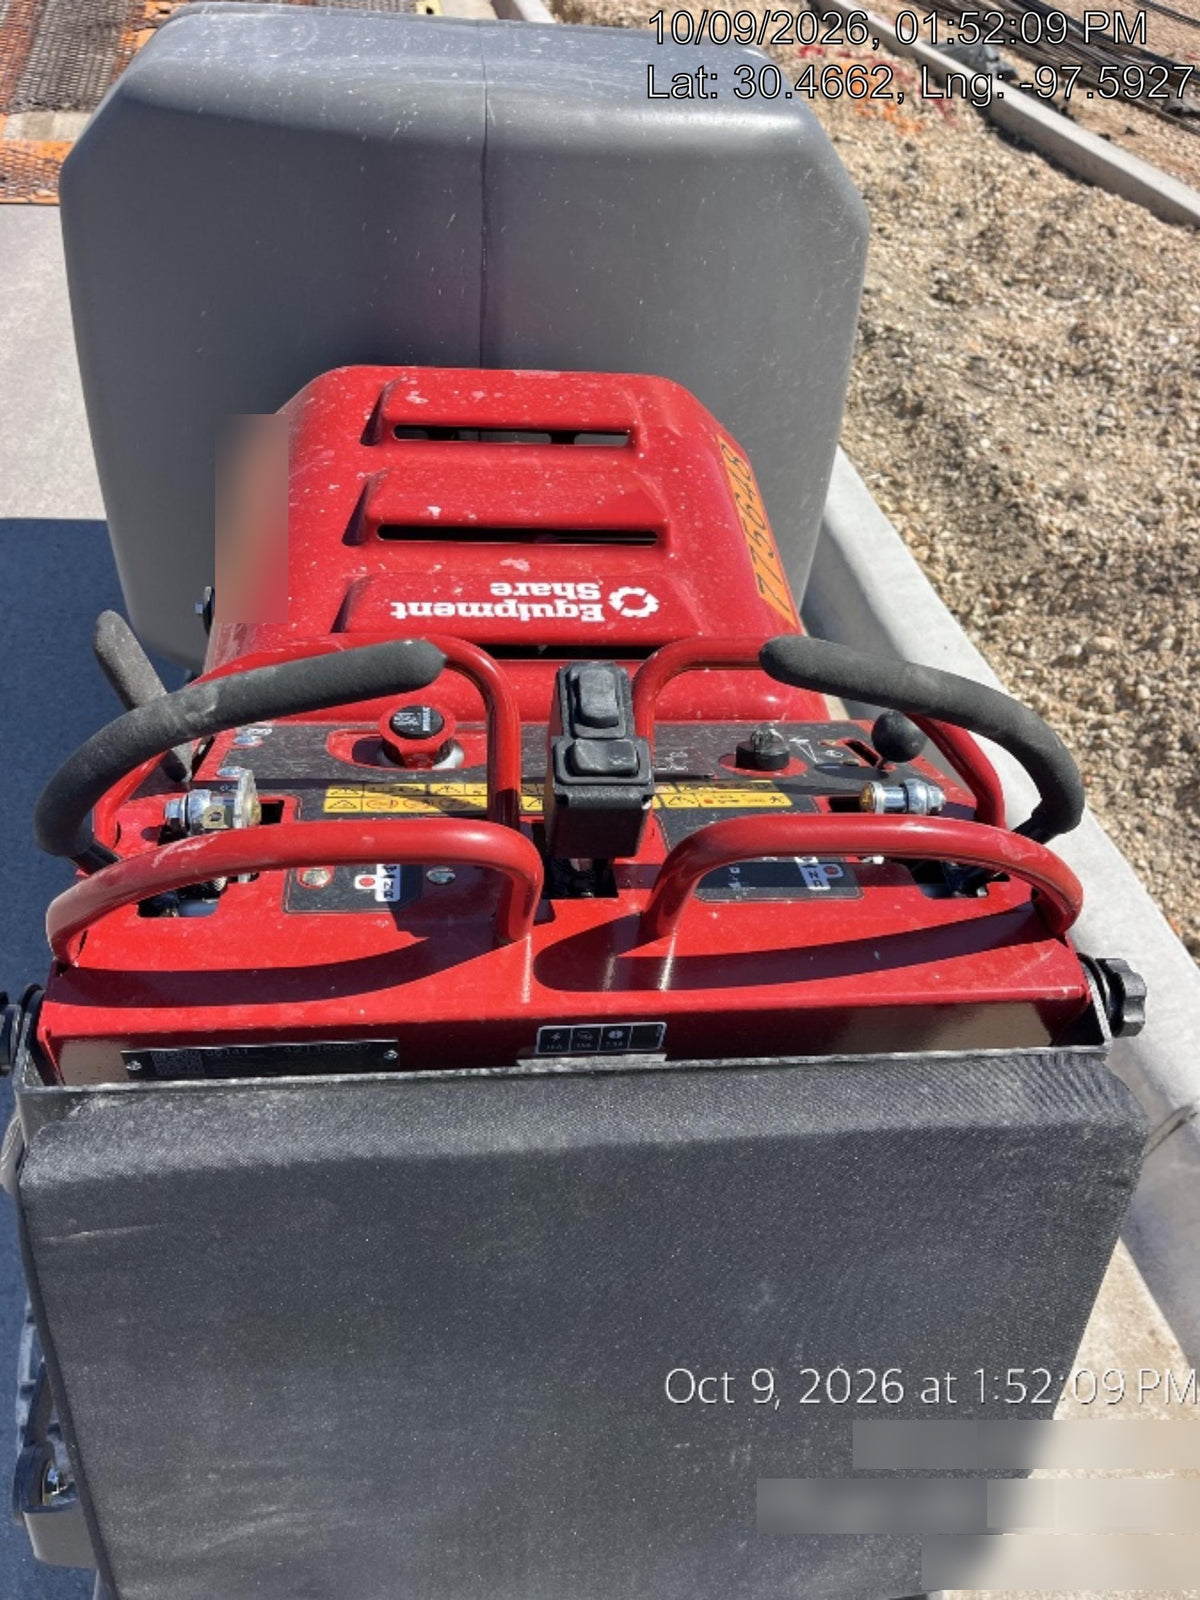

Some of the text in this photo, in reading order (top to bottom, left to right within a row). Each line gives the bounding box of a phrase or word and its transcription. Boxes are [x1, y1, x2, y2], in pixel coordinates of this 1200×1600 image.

[720, 443, 791, 613] 775648
[490, 581, 601, 601] Share
[391, 599, 605, 623] Equipment
